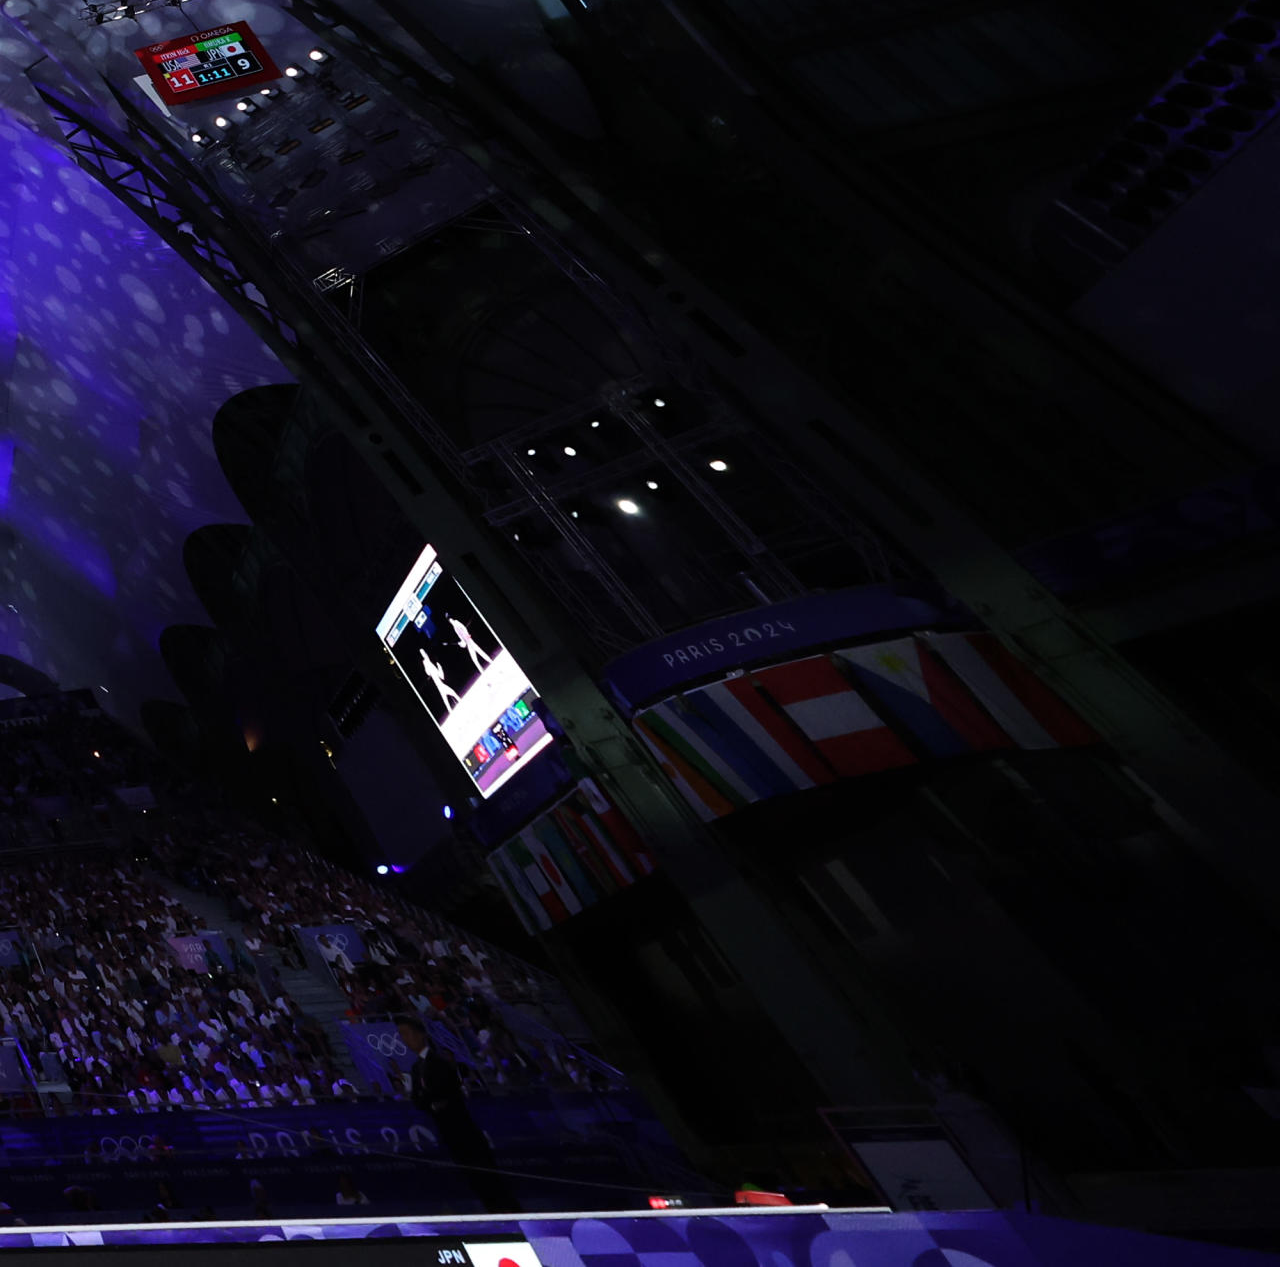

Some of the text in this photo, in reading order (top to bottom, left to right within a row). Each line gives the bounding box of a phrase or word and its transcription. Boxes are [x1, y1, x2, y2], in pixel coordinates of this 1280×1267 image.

[200, 26, 234, 40] OMEGA
[207, 46, 226, 61] JPN
[162, 59, 182, 72] USA
[237, 58, 251, 70] 9
[170, 73, 194, 88] 11
[198, 67, 232, 83] 1:11
[663, 619, 797, 669] PARIS 2024
[437, 1249, 467, 1265] JPN
